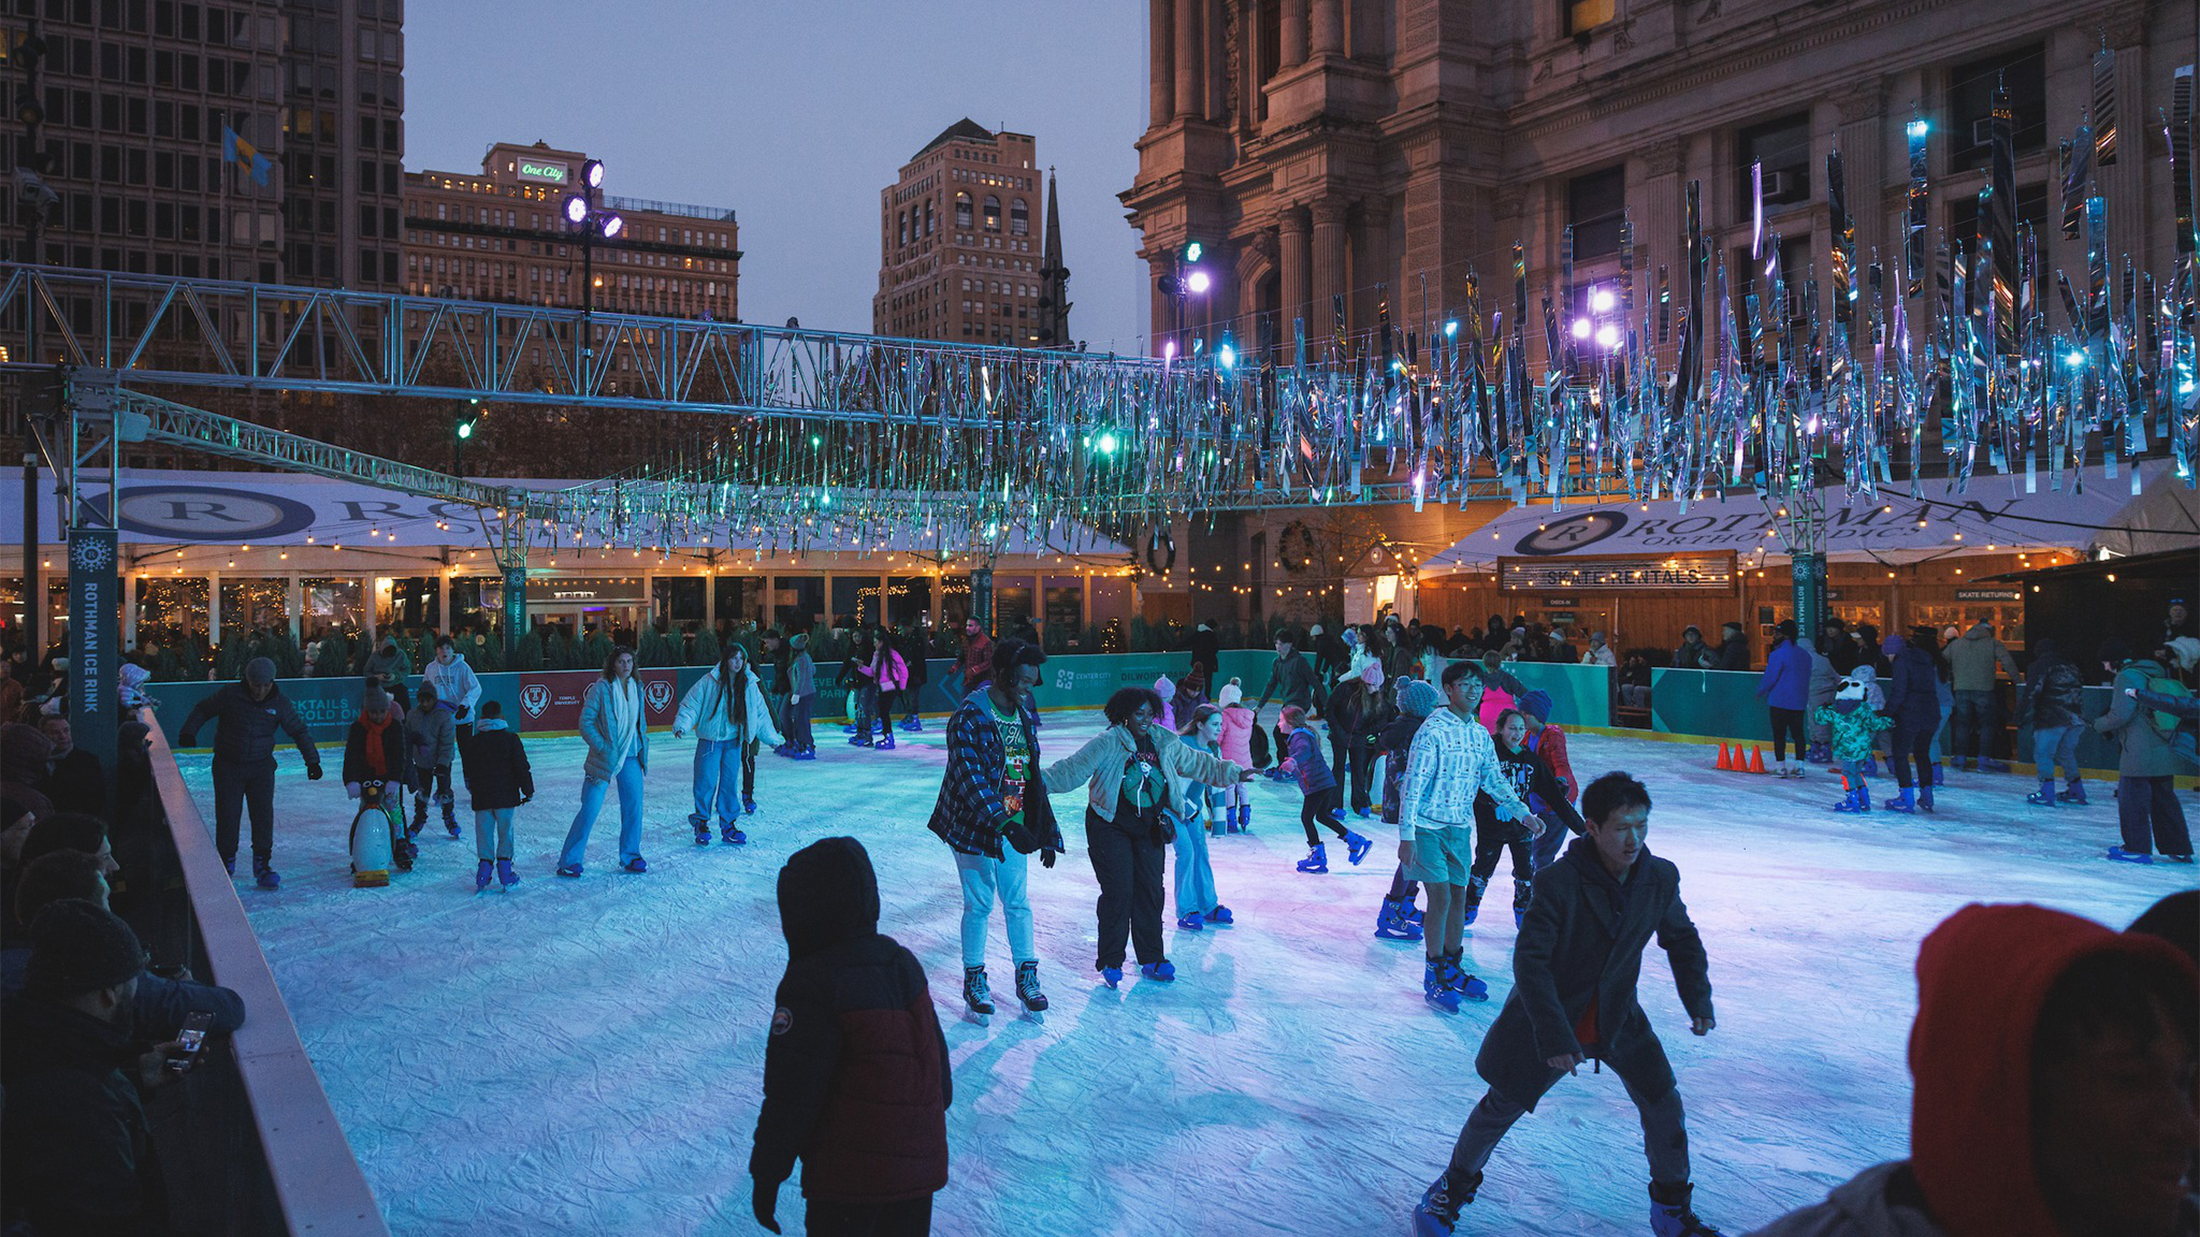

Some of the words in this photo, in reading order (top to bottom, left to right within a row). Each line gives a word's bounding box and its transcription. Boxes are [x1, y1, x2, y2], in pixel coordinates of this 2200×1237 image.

[522, 164, 542, 176] One
[543, 166, 564, 181] City
[160, 500, 250, 523] R
[1548, 525, 1588, 542] R
[1548, 571, 1602, 584] SKATE
[1612, 569, 1699, 584] RENTALS
[84, 583, 98, 650] ROTHMAN
[84, 654, 98, 675] ICE
[1121, 671, 1167, 681] DILWORT
[84, 679, 98, 713] RINK
[296, 698, 349, 710] KTAILS
